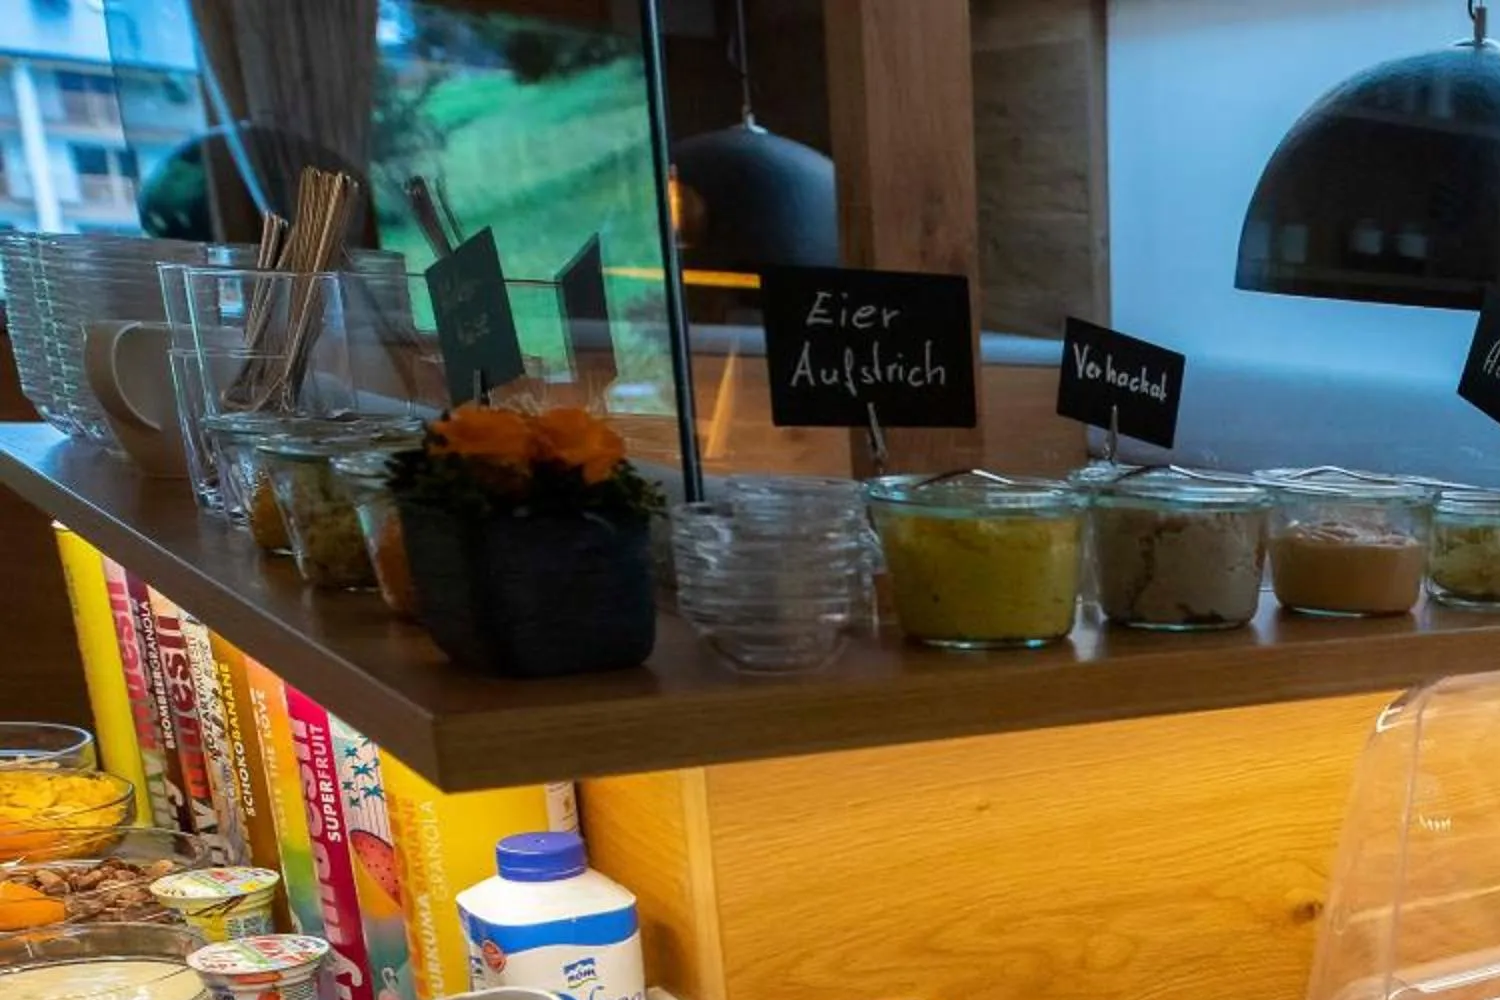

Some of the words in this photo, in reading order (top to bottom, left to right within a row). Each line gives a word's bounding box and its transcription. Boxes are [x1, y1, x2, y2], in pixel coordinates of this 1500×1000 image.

[805, 291, 902, 328] Eier
[790, 339, 946, 396] Aufstrich
[140, 600, 176, 750] BROMBEERGRANOLA
[256, 689, 272, 737] LOVE
[311, 724, 343, 843] SUPERFRUIT
